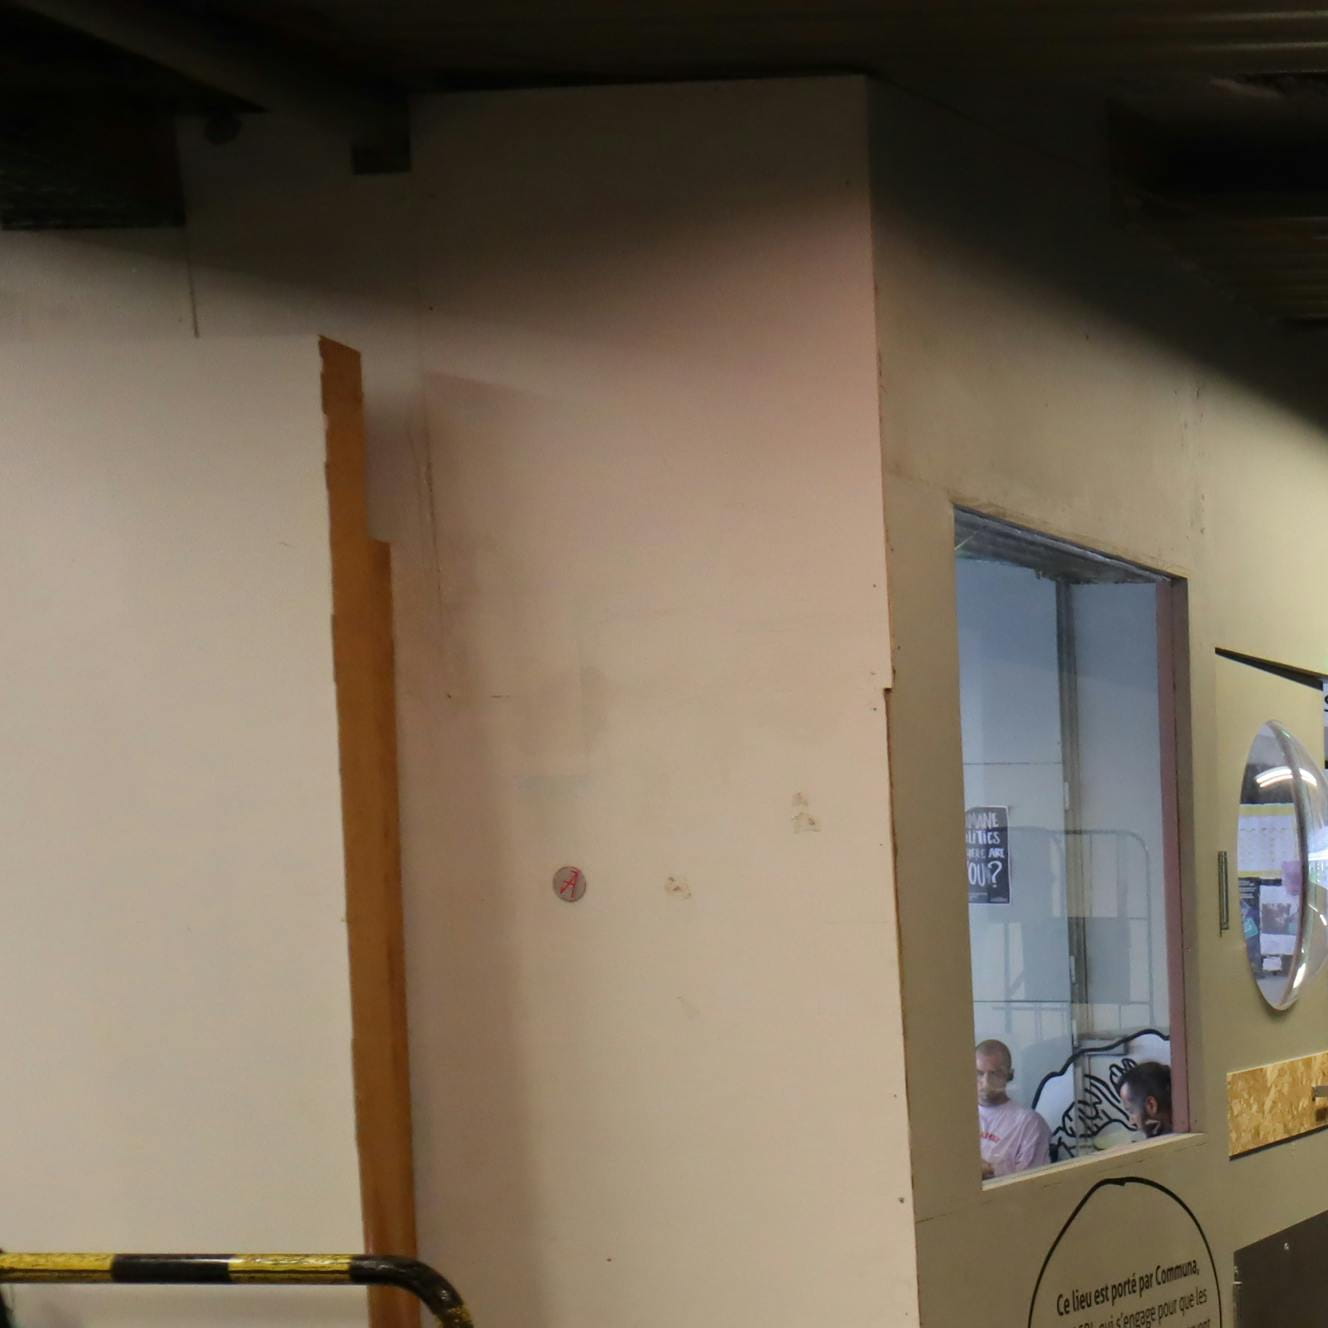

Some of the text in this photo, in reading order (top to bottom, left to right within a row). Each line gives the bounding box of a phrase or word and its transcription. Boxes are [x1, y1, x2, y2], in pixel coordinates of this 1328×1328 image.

[968, 860, 1003, 888] OU?
[1057, 1259, 1200, 1317] Ce lieu est porté par Communa,
[1157, 1299, 1178, 1327] pour
[1179, 1292, 1195, 1317] que
[1196, 1286, 1208, 1307] les
